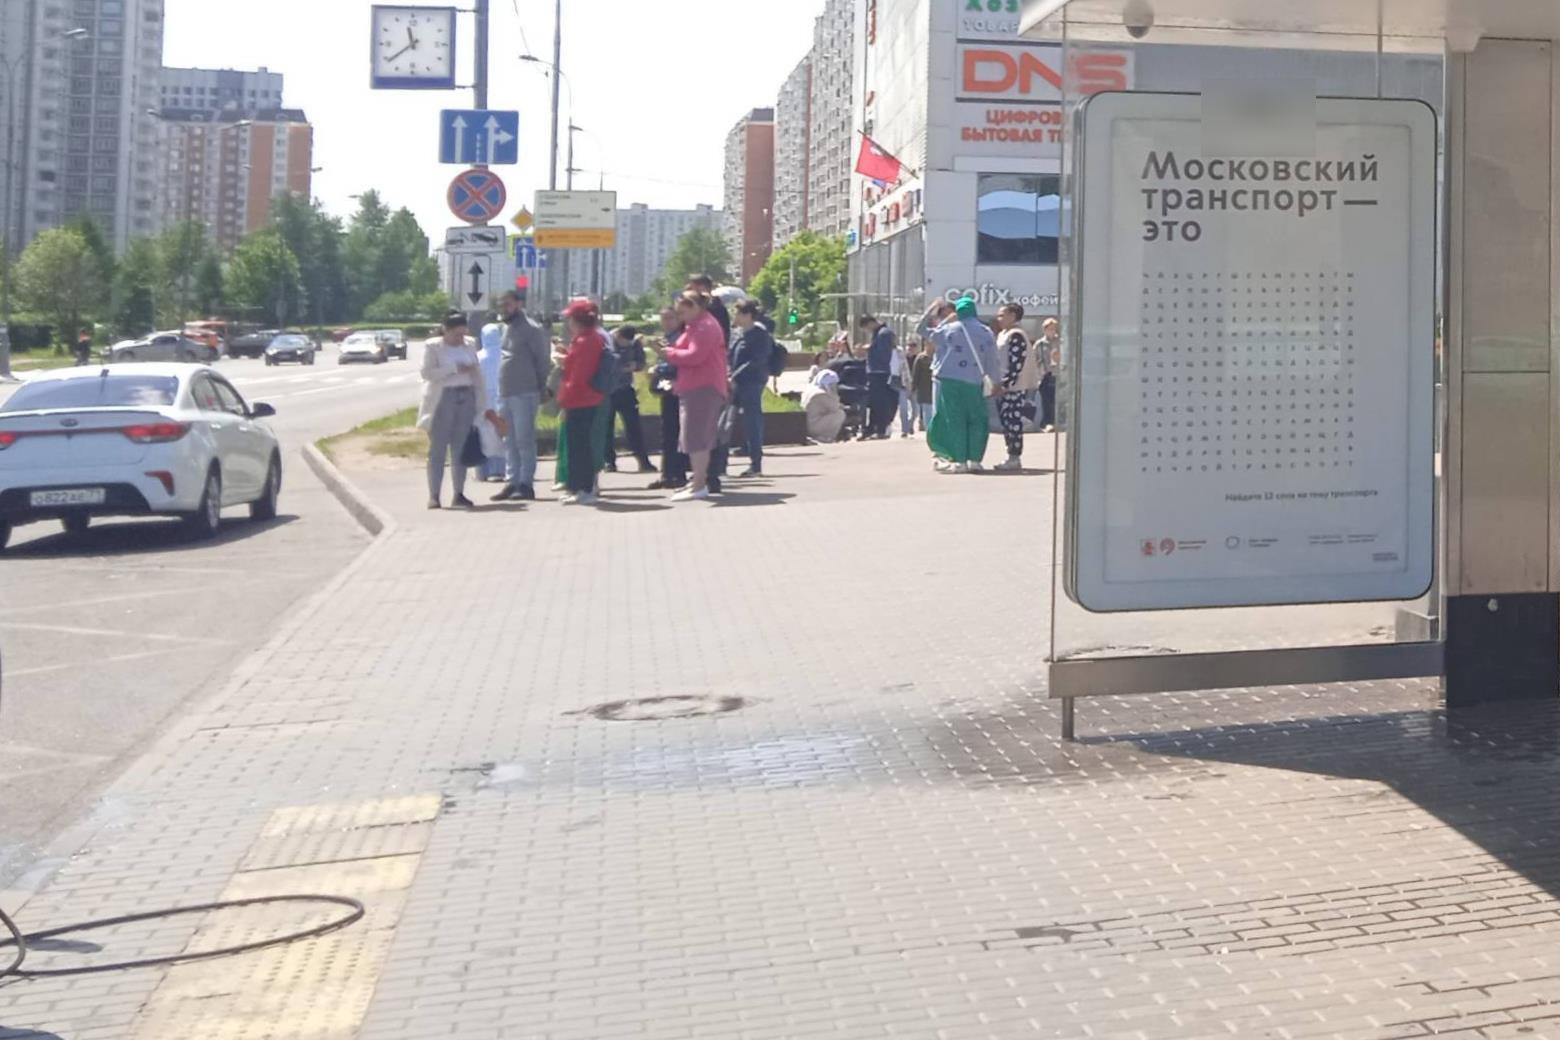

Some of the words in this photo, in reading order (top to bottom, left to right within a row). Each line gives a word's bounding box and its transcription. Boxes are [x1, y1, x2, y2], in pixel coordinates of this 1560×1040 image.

[962, 49, 1127, 96] DNS
[961, 127, 1042, 143] БЫТОВАЯ
[1141, 151, 1378, 182] Московский
[1141, 187, 1337, 217] транспорт
[1142, 219, 1202, 242] это
[944, 283, 1010, 305] cofix
